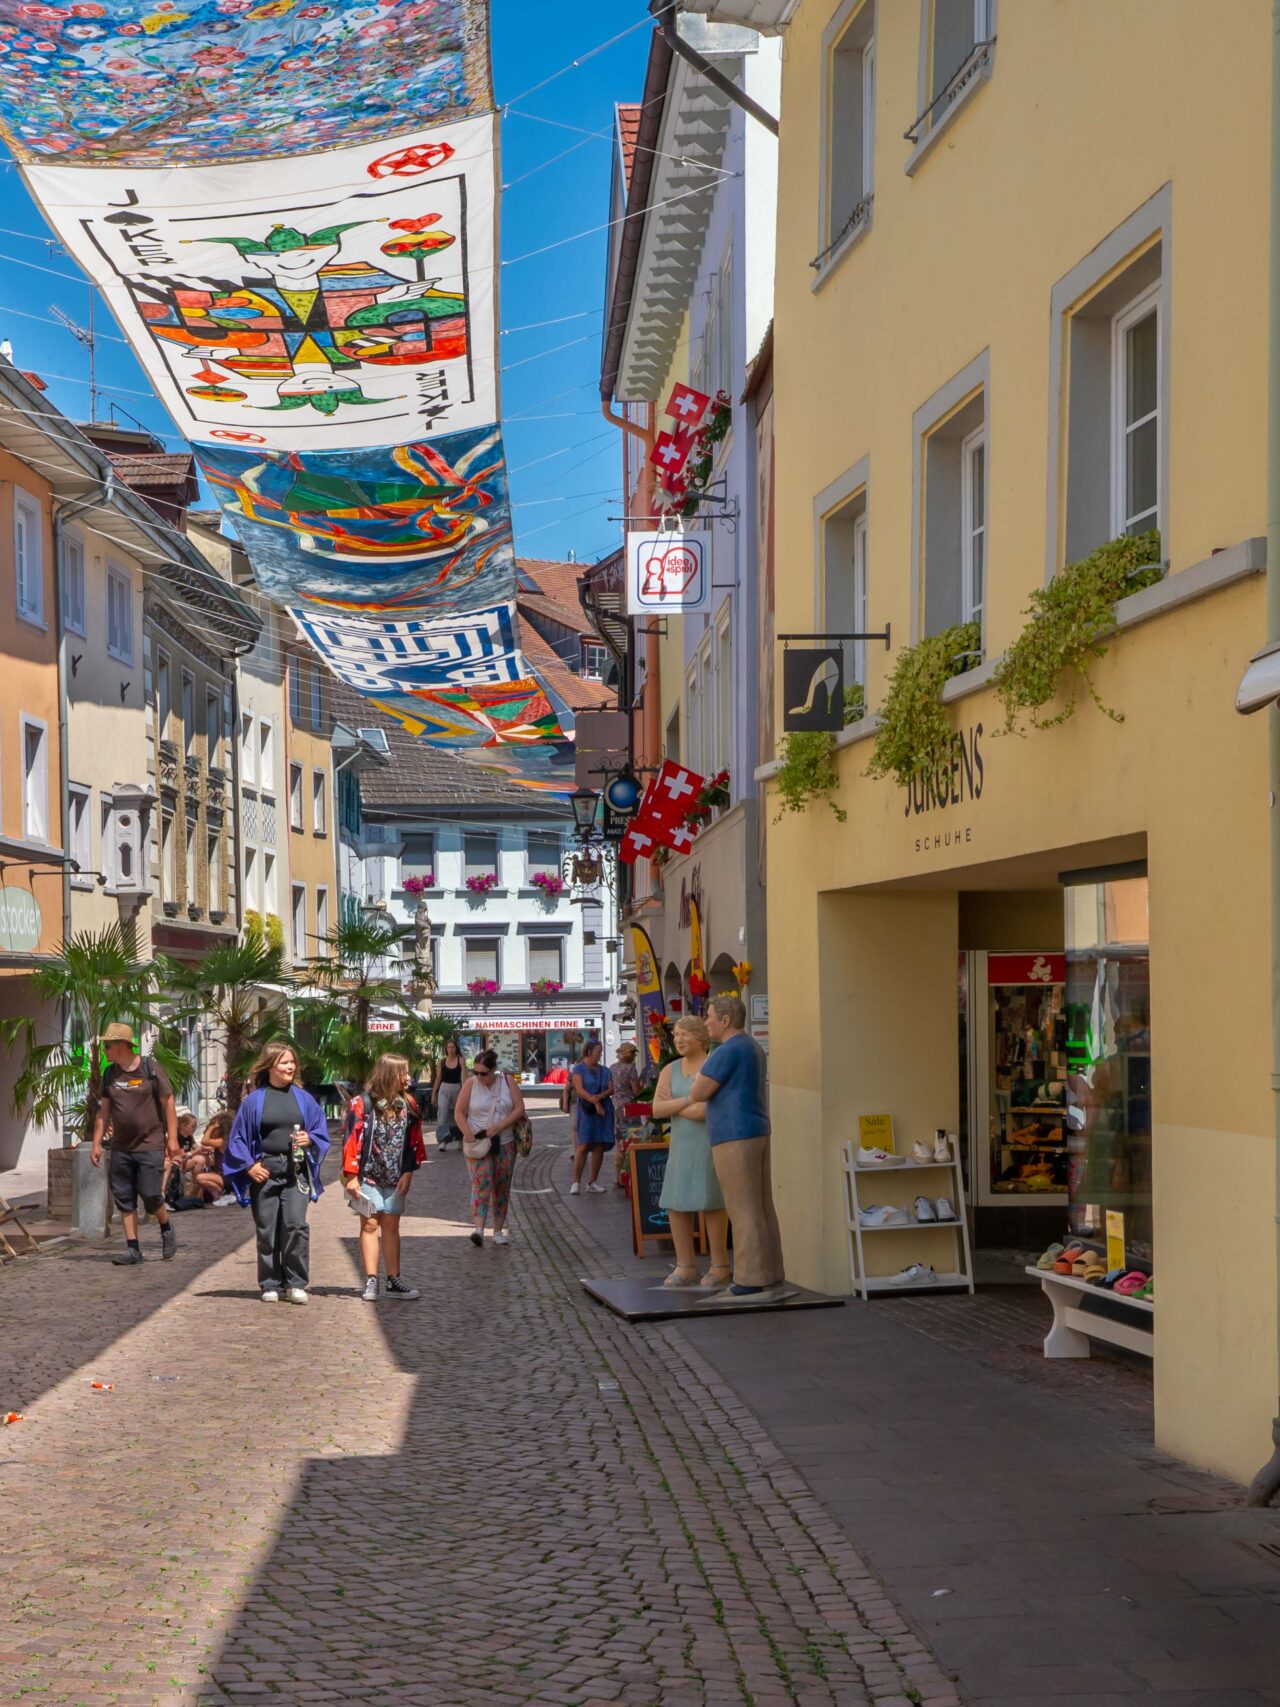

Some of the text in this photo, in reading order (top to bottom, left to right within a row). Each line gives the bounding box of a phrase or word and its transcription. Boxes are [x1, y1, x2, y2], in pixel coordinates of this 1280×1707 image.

[667, 556, 690, 566] idee
[915, 828, 972, 852] SCHUHE
[553, 1020, 579, 1028] ERNE
